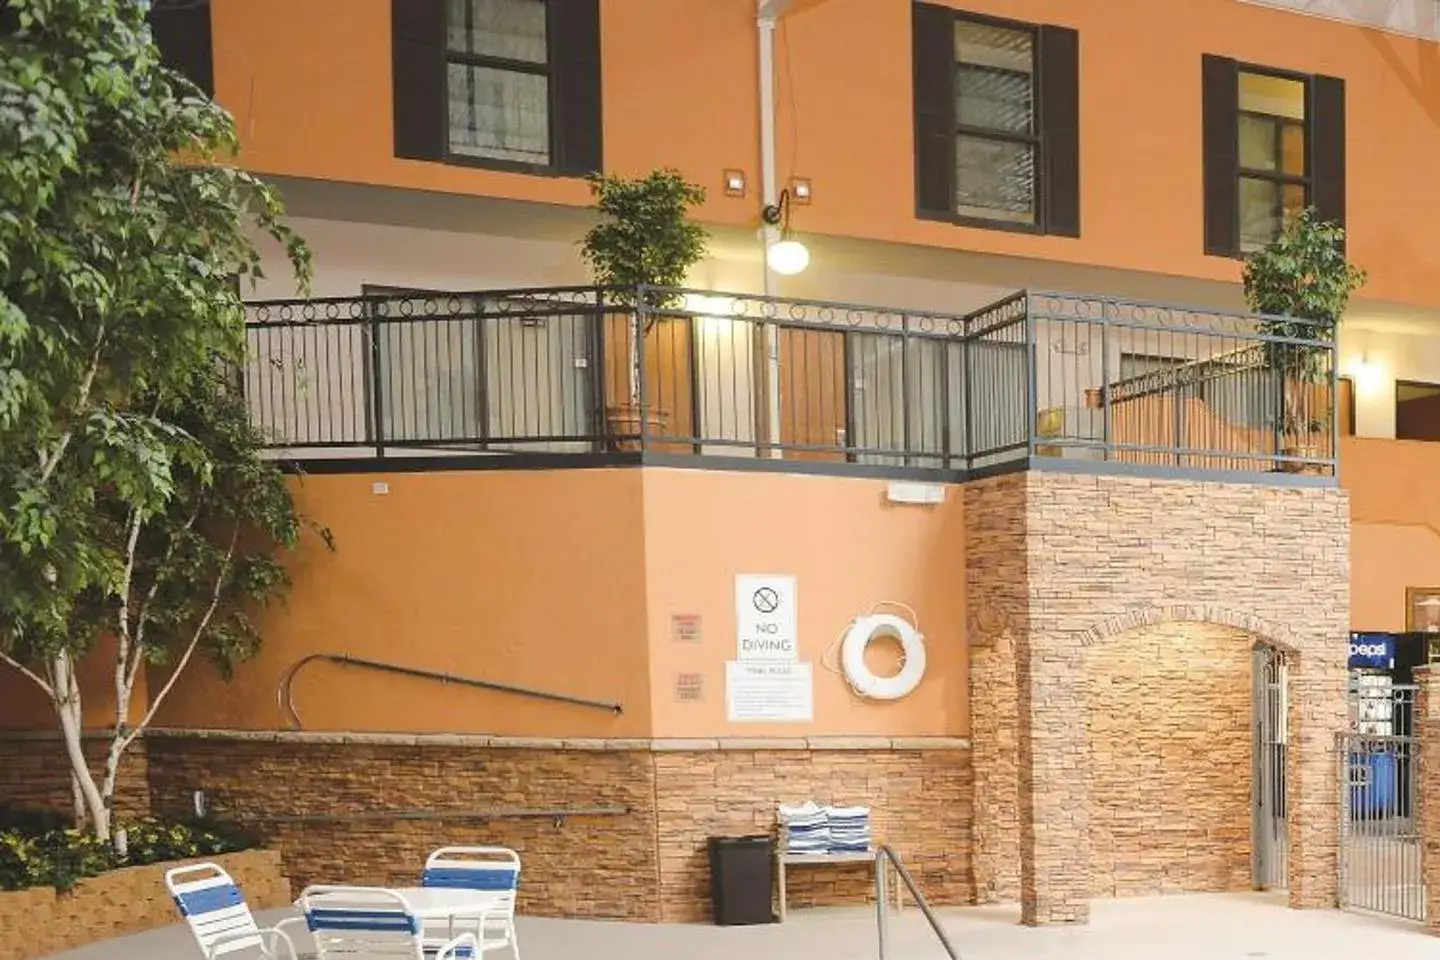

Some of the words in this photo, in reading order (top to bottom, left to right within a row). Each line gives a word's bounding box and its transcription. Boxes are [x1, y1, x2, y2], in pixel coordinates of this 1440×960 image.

[755, 623, 779, 634] NO
[742, 639, 793, 652] DIVING
[1348, 642, 1386, 658] pepsi
